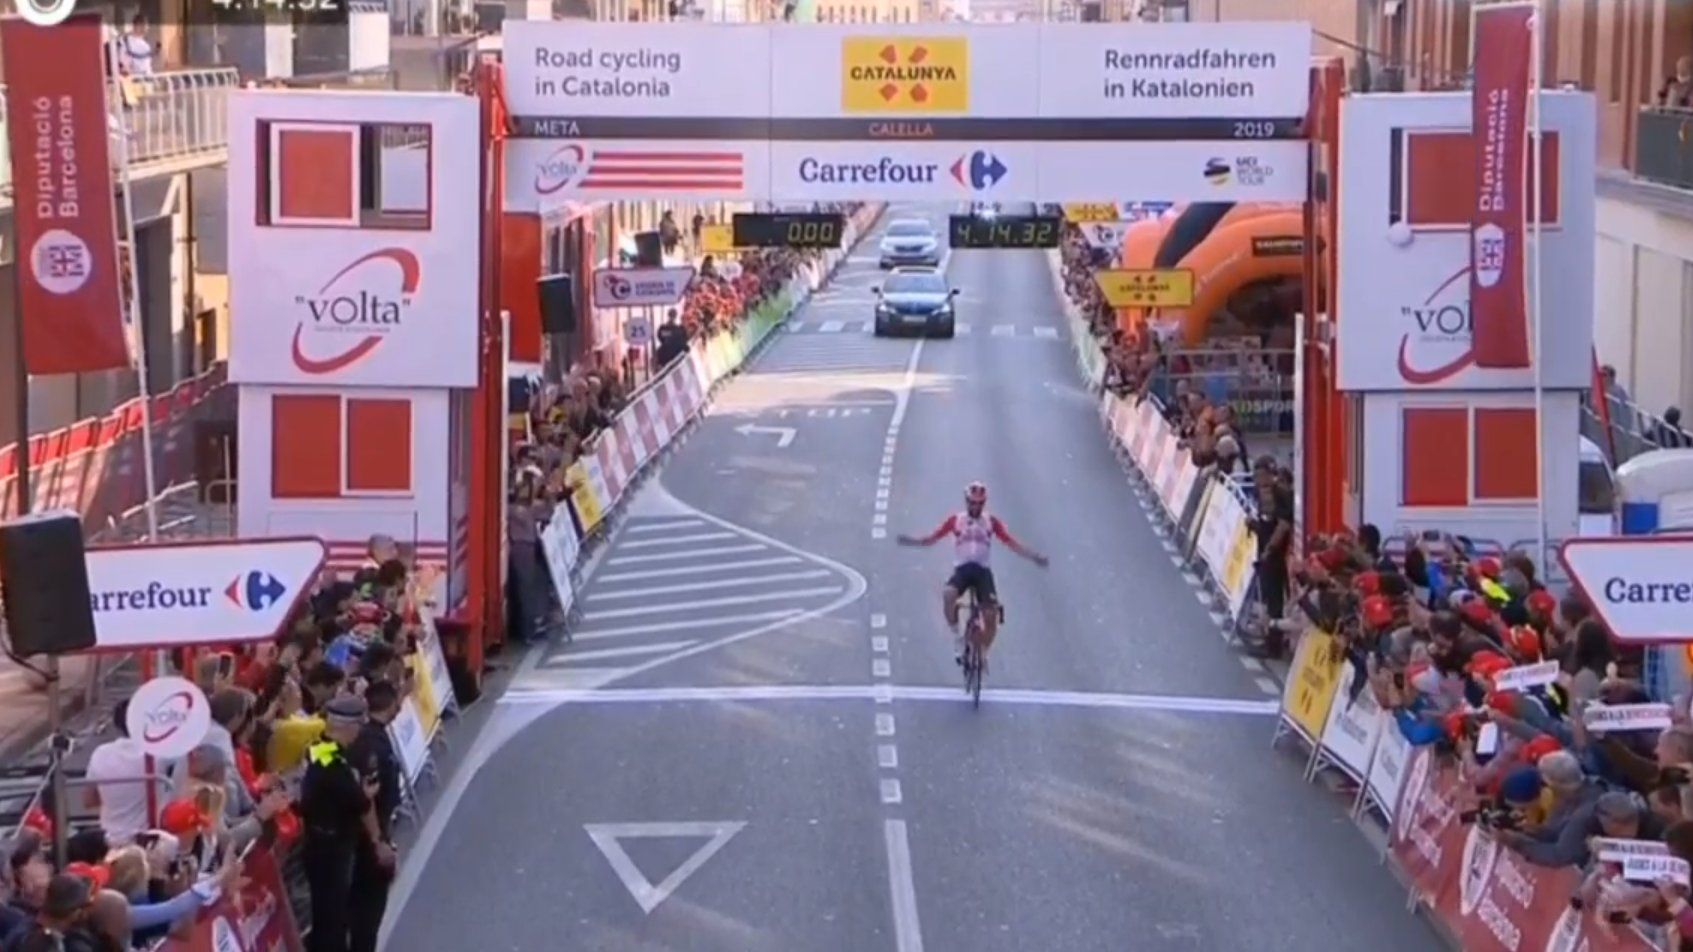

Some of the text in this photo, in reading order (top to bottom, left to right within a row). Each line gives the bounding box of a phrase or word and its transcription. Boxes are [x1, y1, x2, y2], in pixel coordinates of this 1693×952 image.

[535, 47, 681, 73] Road cycling
[1104, 48, 1276, 69] Rennradfahren
[850, 66, 957, 80] CATALUNYA
[535, 75, 671, 97] in Catalonia
[1104, 78, 1255, 98] in Katalonien
[534, 120, 580, 136] META
[868, 122, 933, 136] CALELLA
[1233, 121, 1275, 138] 2019
[33, 95, 55, 218] Diputació
[57, 94, 79, 217] Barcelona
[1479, 88, 1499, 212] Diputació
[798, 156, 939, 183] Carrefour
[89, 580, 212, 611] arrefour
[1604, 576, 1693, 604] Carre
